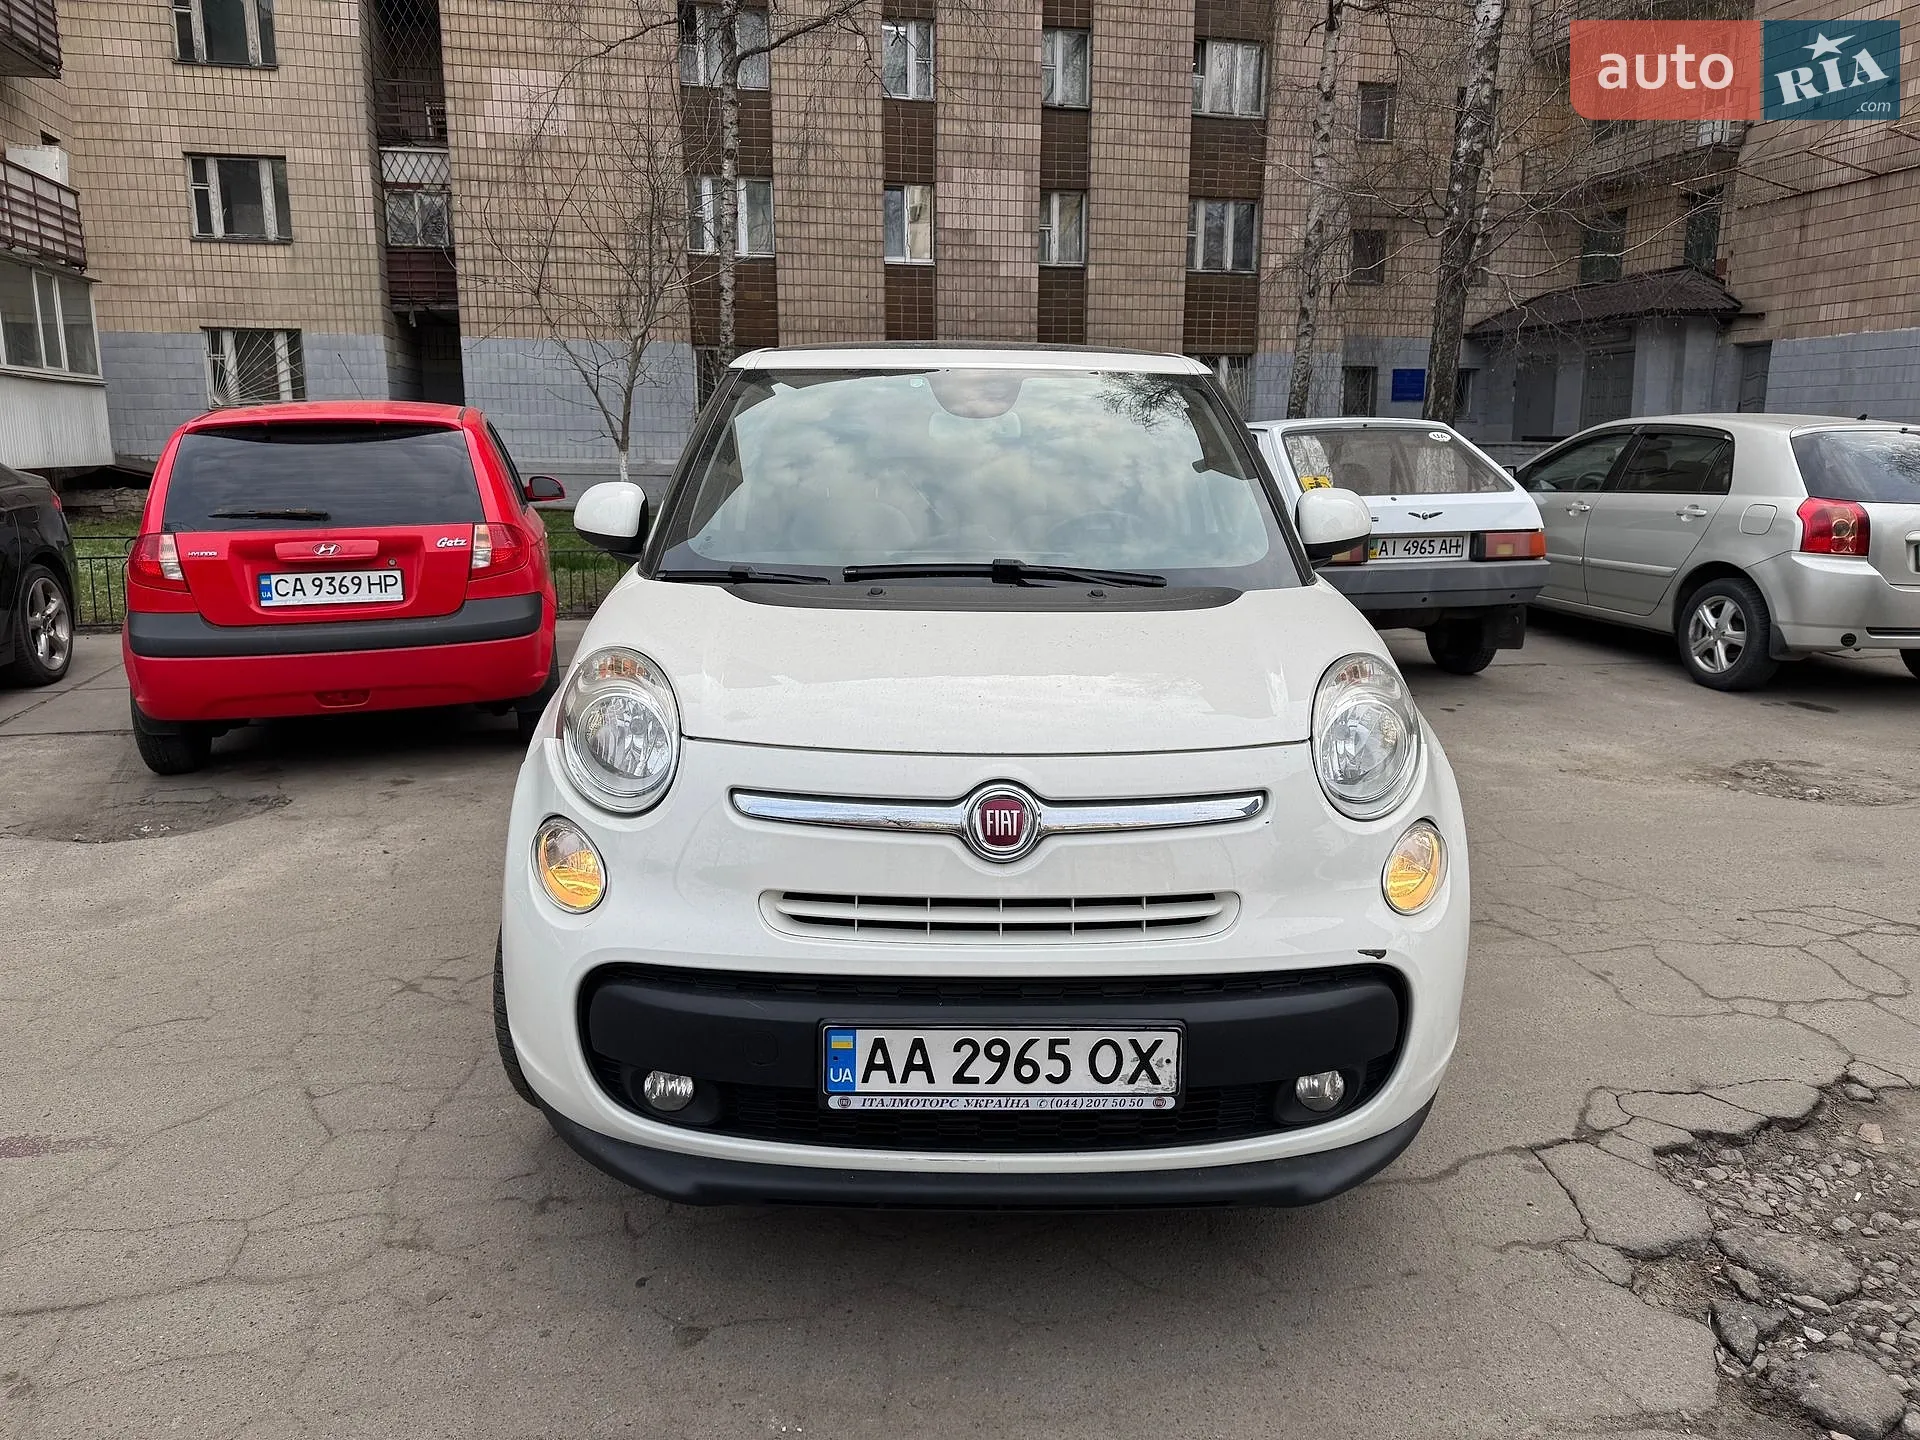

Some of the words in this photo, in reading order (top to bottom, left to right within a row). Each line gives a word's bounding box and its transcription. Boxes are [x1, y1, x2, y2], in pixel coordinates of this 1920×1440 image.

[436, 537, 467, 547] Getz
[1379, 540, 1396, 556] AI
[1403, 540, 1435, 555] 4965
[1438, 539, 1460, 554] AH
[274, 577, 307, 597] CA
[311, 576, 362, 597] 9369
[367, 574, 398, 594] HP
[986, 809, 1020, 836] FIAT
[861, 1037, 936, 1084] AA
[952, 1037, 1071, 1085] 2965
[1088, 1038, 1164, 1085] OX
[830, 1067, 853, 1082] UA
[861, 1098, 959, 1108] ІТАЛМОТОРС
[963, 1097, 1030, 1108] УКРАЇНА
